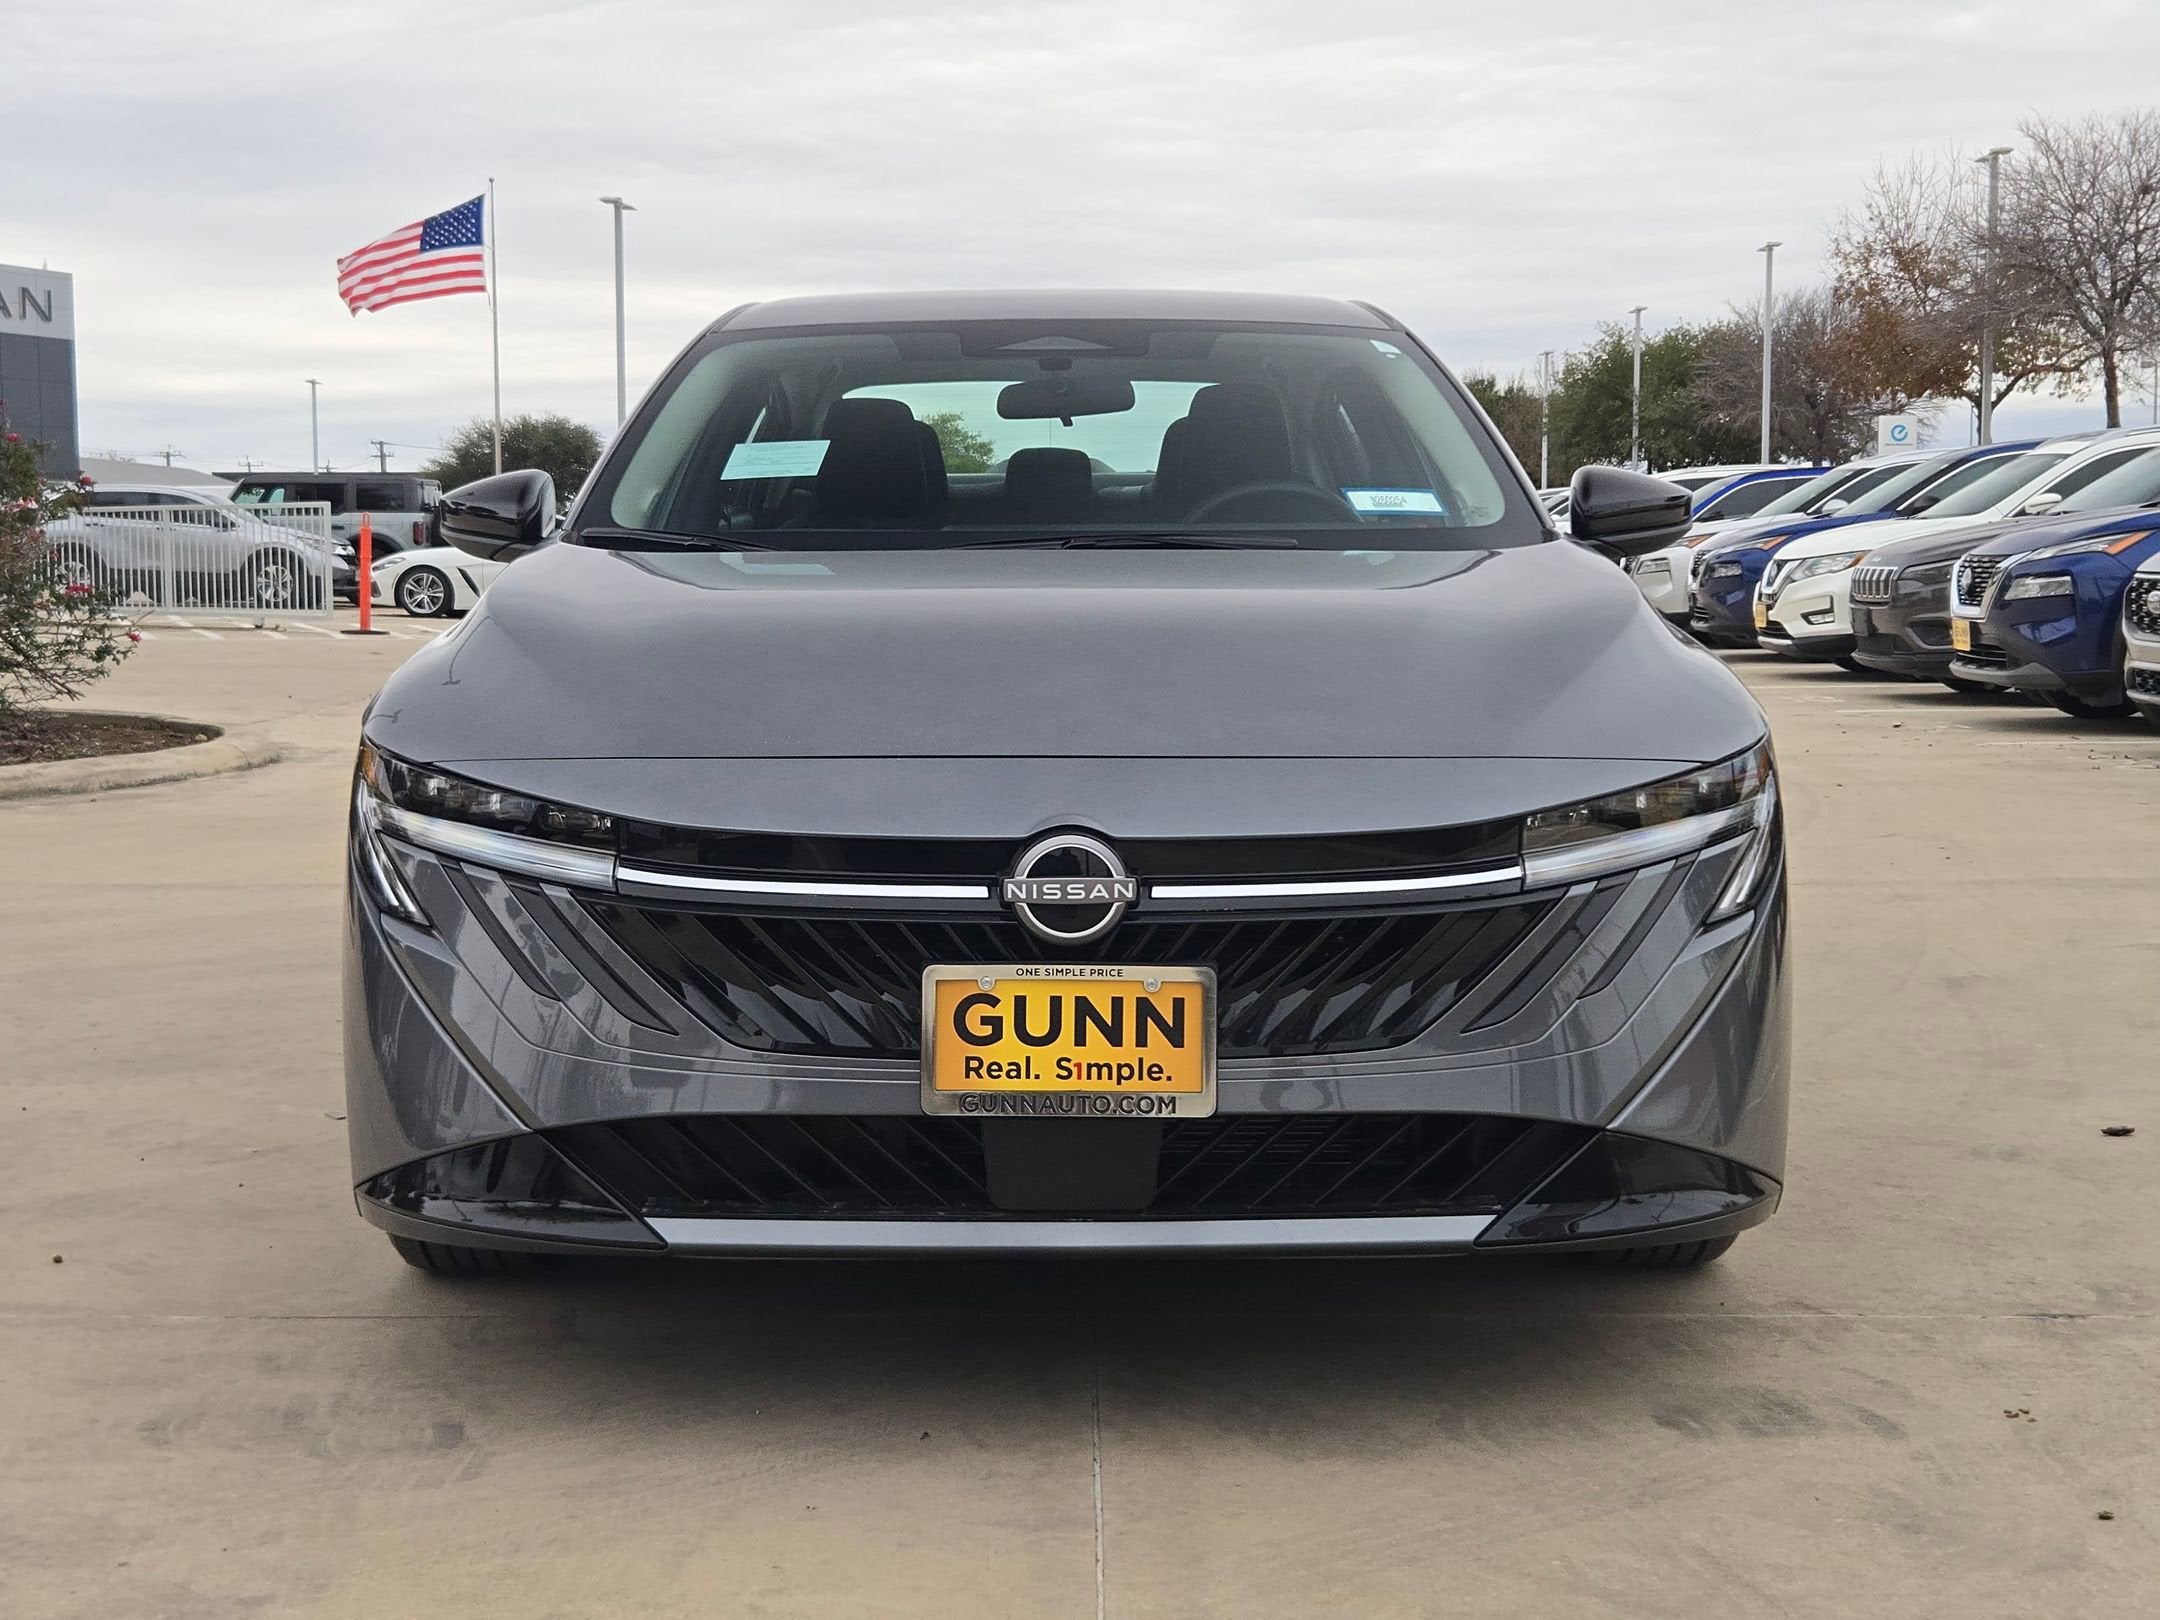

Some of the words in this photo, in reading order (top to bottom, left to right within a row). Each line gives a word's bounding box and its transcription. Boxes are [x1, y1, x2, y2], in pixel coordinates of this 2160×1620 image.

[1007, 883, 1133, 899] NISSAN
[1016, 967, 1041, 977] ONE
[1044, 968, 1086, 977] SIMPLE
[1089, 968, 1124, 978] PRICE
[953, 992, 1186, 1049] GUNN
[964, 1056, 1040, 1080] Real.
[960, 1093, 1177, 1115] GUNNAUTO.COM
